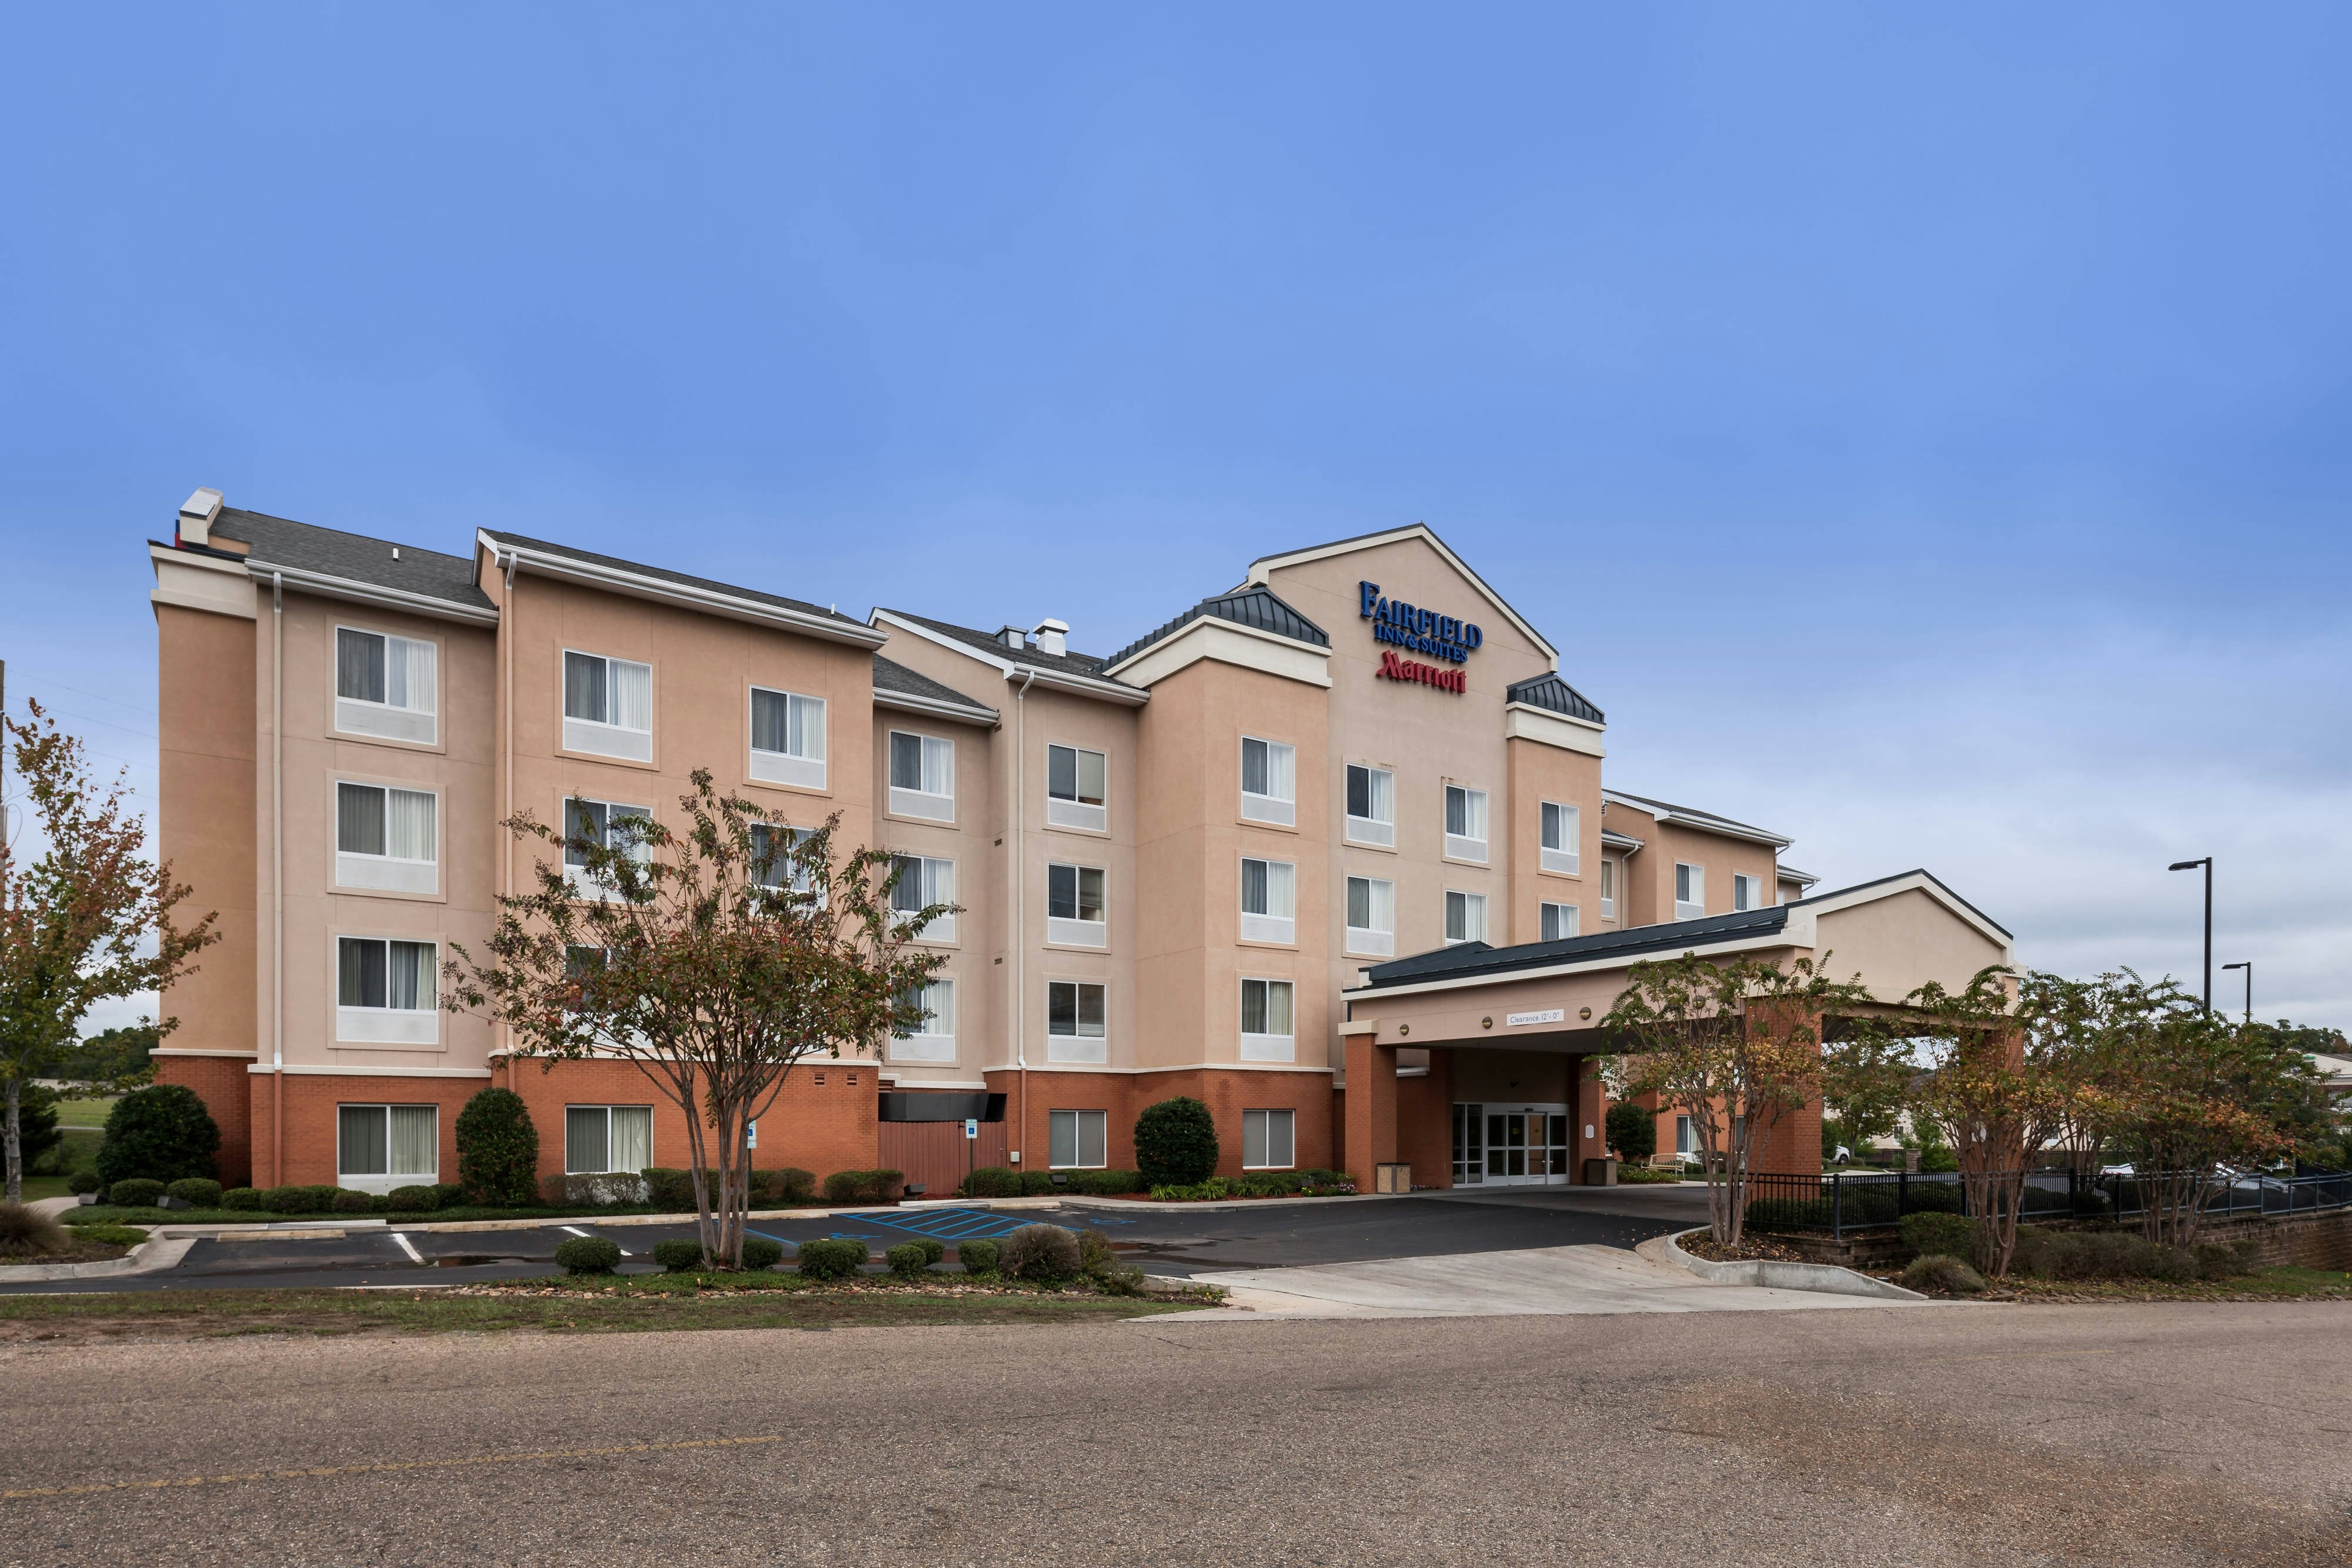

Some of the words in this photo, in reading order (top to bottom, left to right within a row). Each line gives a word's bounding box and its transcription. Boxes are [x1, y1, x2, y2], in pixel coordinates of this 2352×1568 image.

[1359, 580, 1483, 648] FAIRFIELD
[1375, 623, 1406, 646] INN
[1406, 634, 1419, 649] &
[1419, 637, 1468, 663] SUITES
[1376, 650, 1466, 694] Marriott
